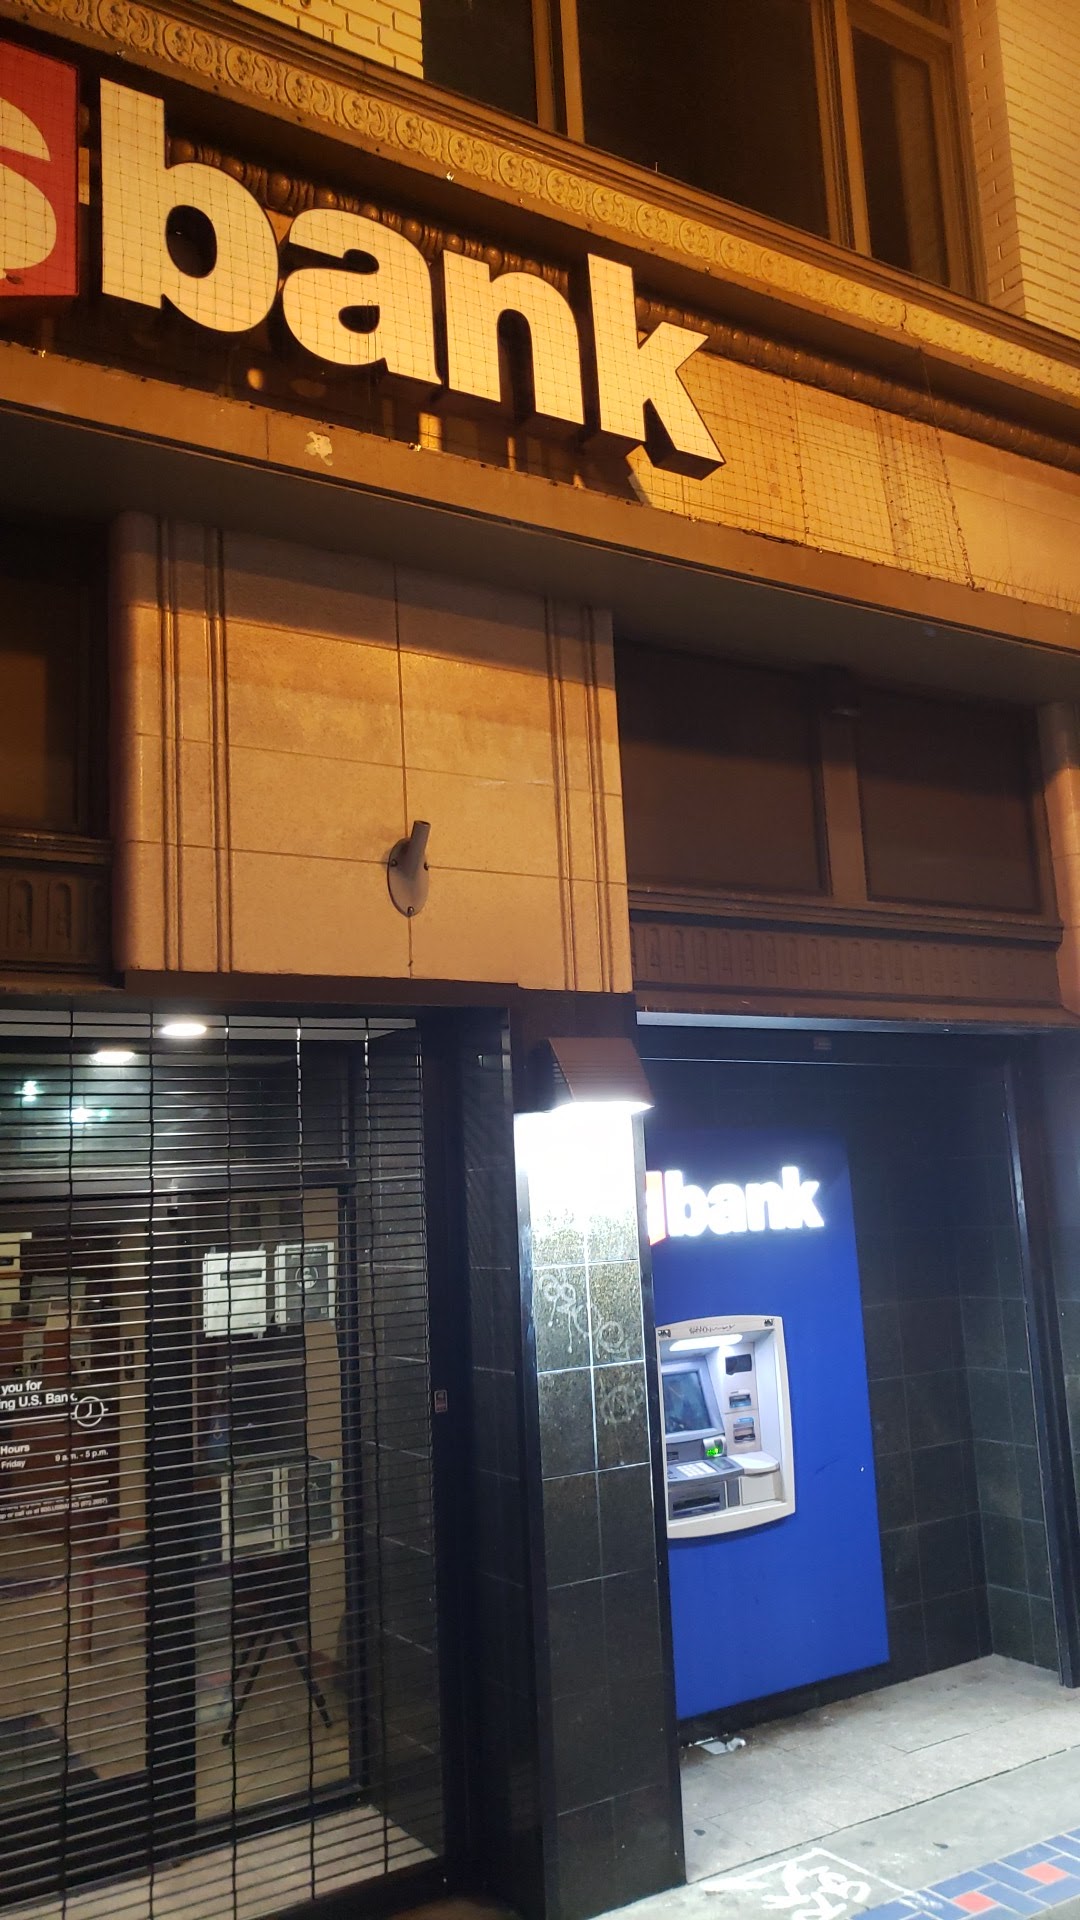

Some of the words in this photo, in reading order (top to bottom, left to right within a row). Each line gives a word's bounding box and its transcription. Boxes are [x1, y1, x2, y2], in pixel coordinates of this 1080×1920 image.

[100, 77, 725, 468] bank
[664, 1166, 825, 1237] bank
[1, 1383, 23, 1396] you
[25, 1380, 42, 1391] for
[0, 1399, 16, 1411] ng
[19, 1394, 42, 1408] U.S.
[0, 1444, 30, 1455] Hours
[1, 1460, 26, 1469] Friday
